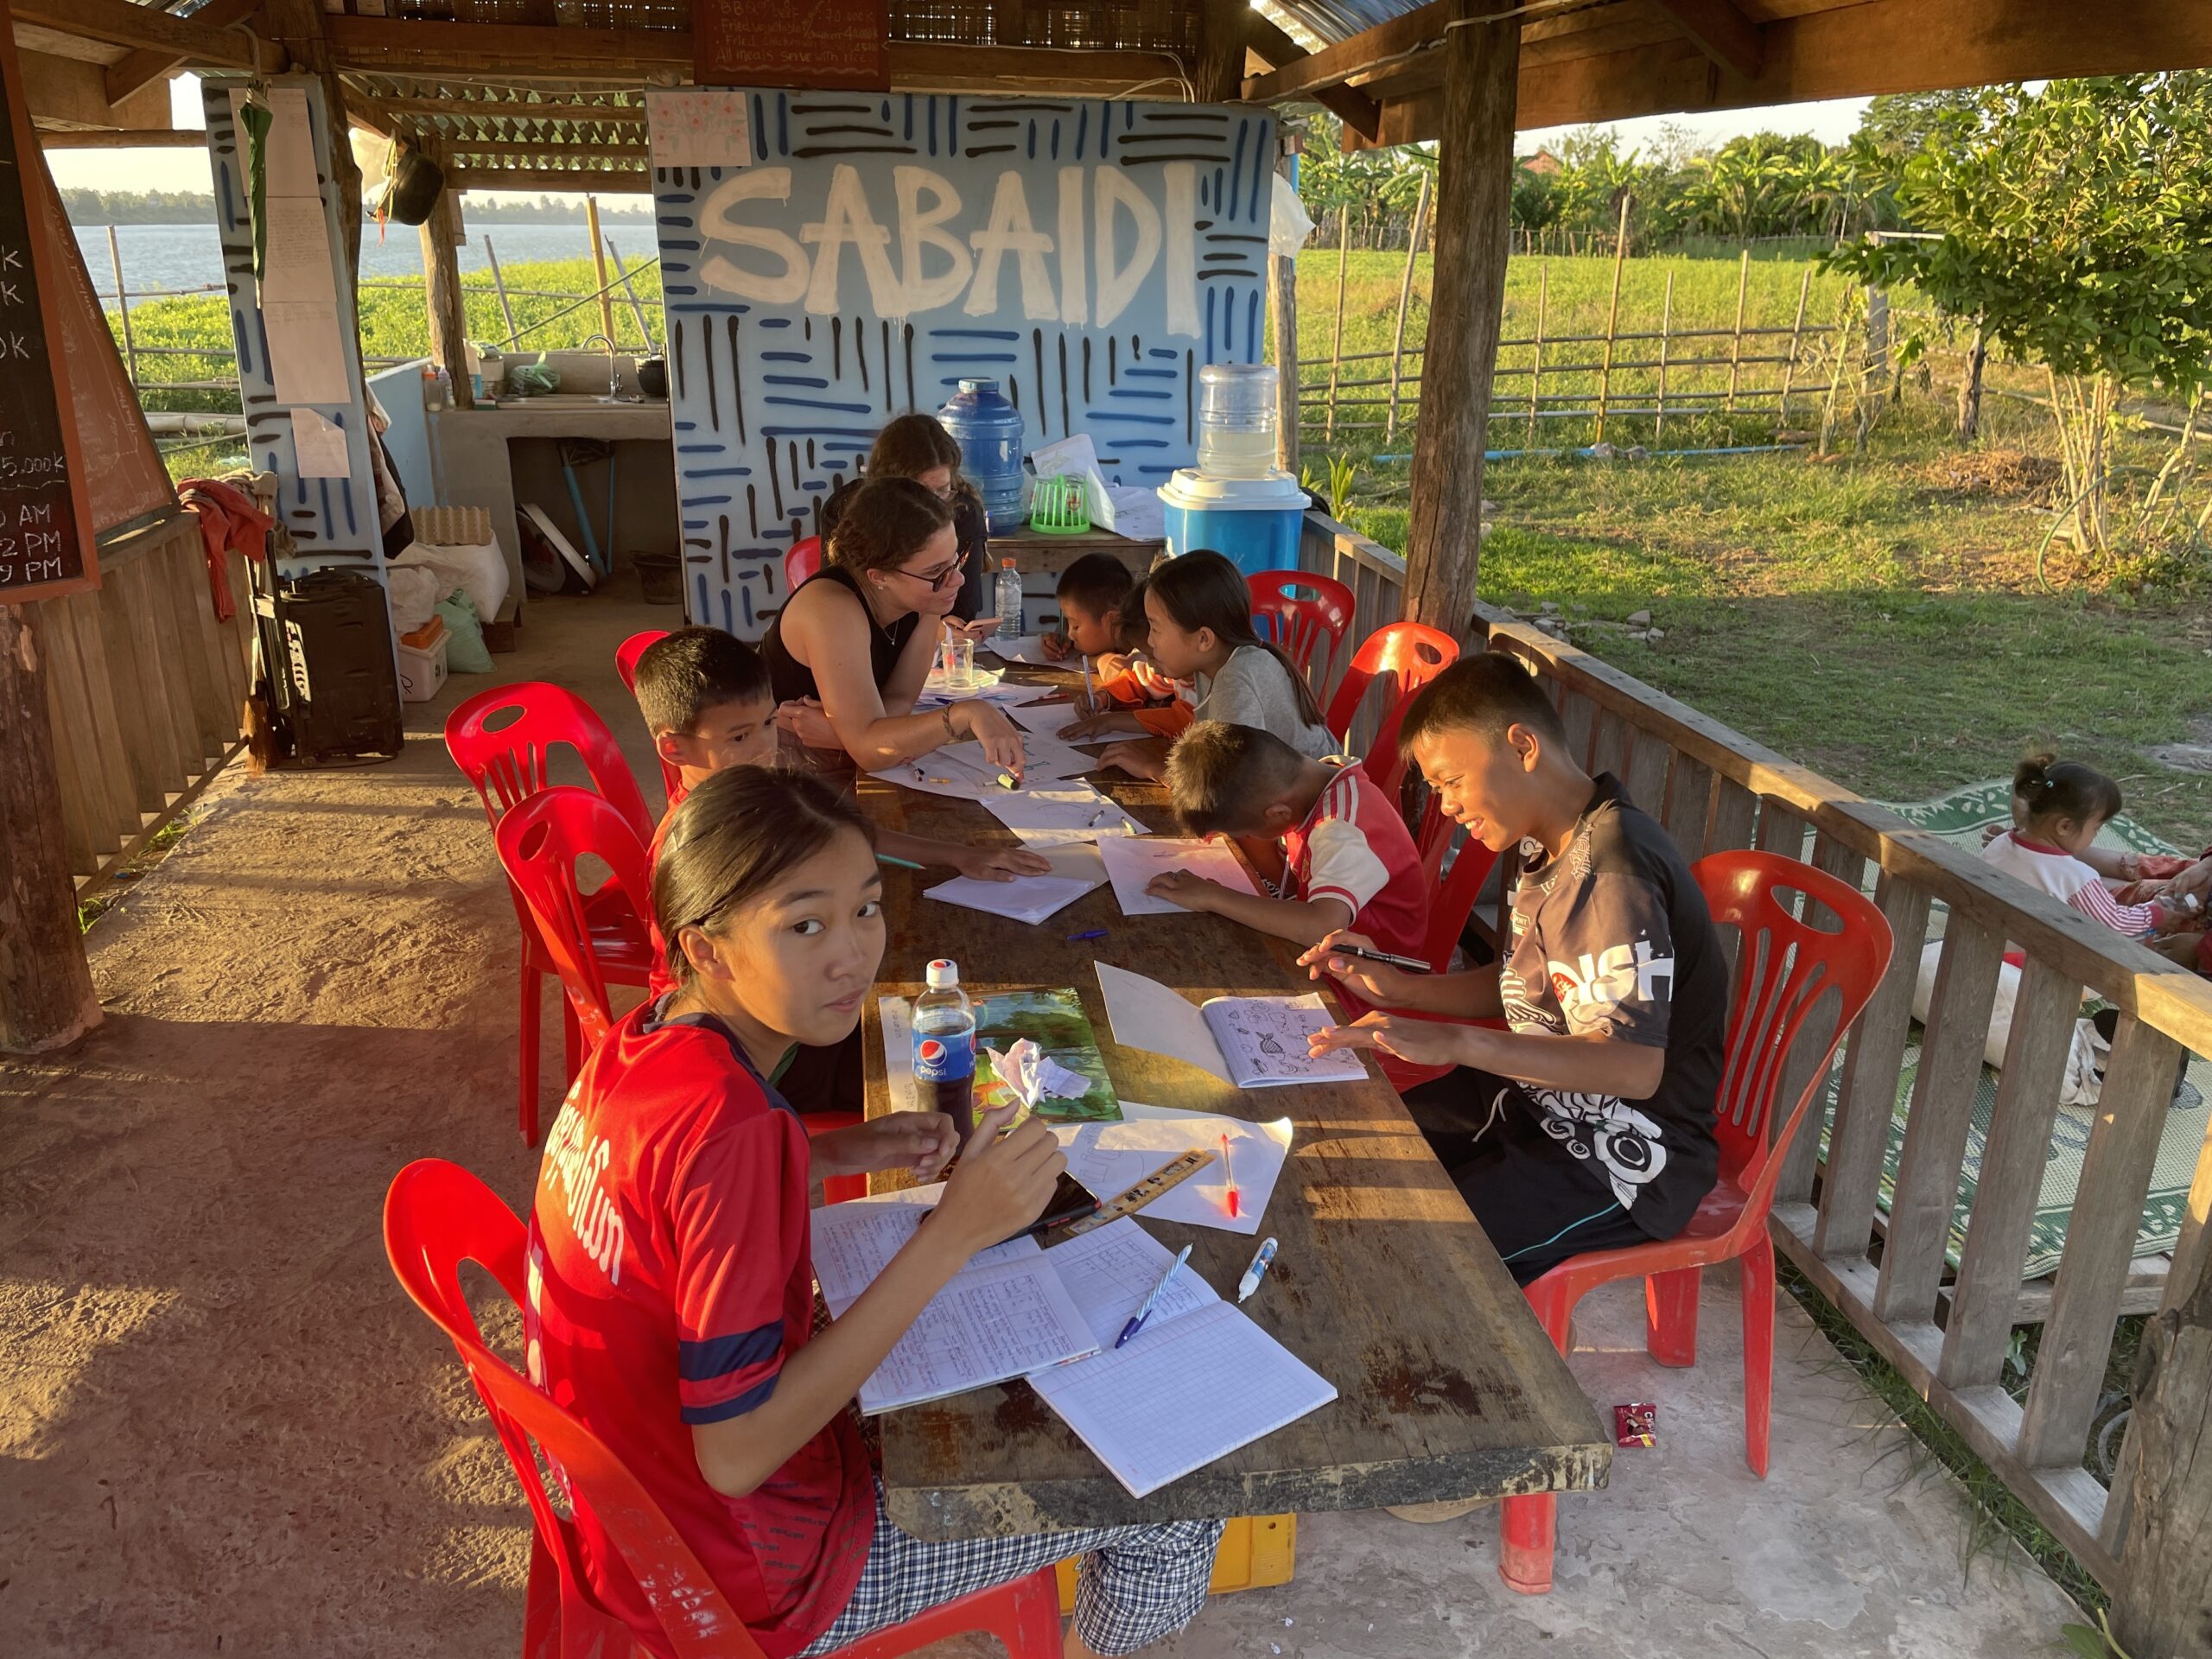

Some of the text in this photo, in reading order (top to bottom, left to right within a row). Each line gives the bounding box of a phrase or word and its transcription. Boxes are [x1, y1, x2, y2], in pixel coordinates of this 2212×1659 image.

[699, 163, 1202, 340] SABAIDI
[19, 503, 51, 527] AM
[24, 530, 61, 558] PM
[25, 556, 62, 582] PM
[919, 1065, 948, 1078] pepsi
